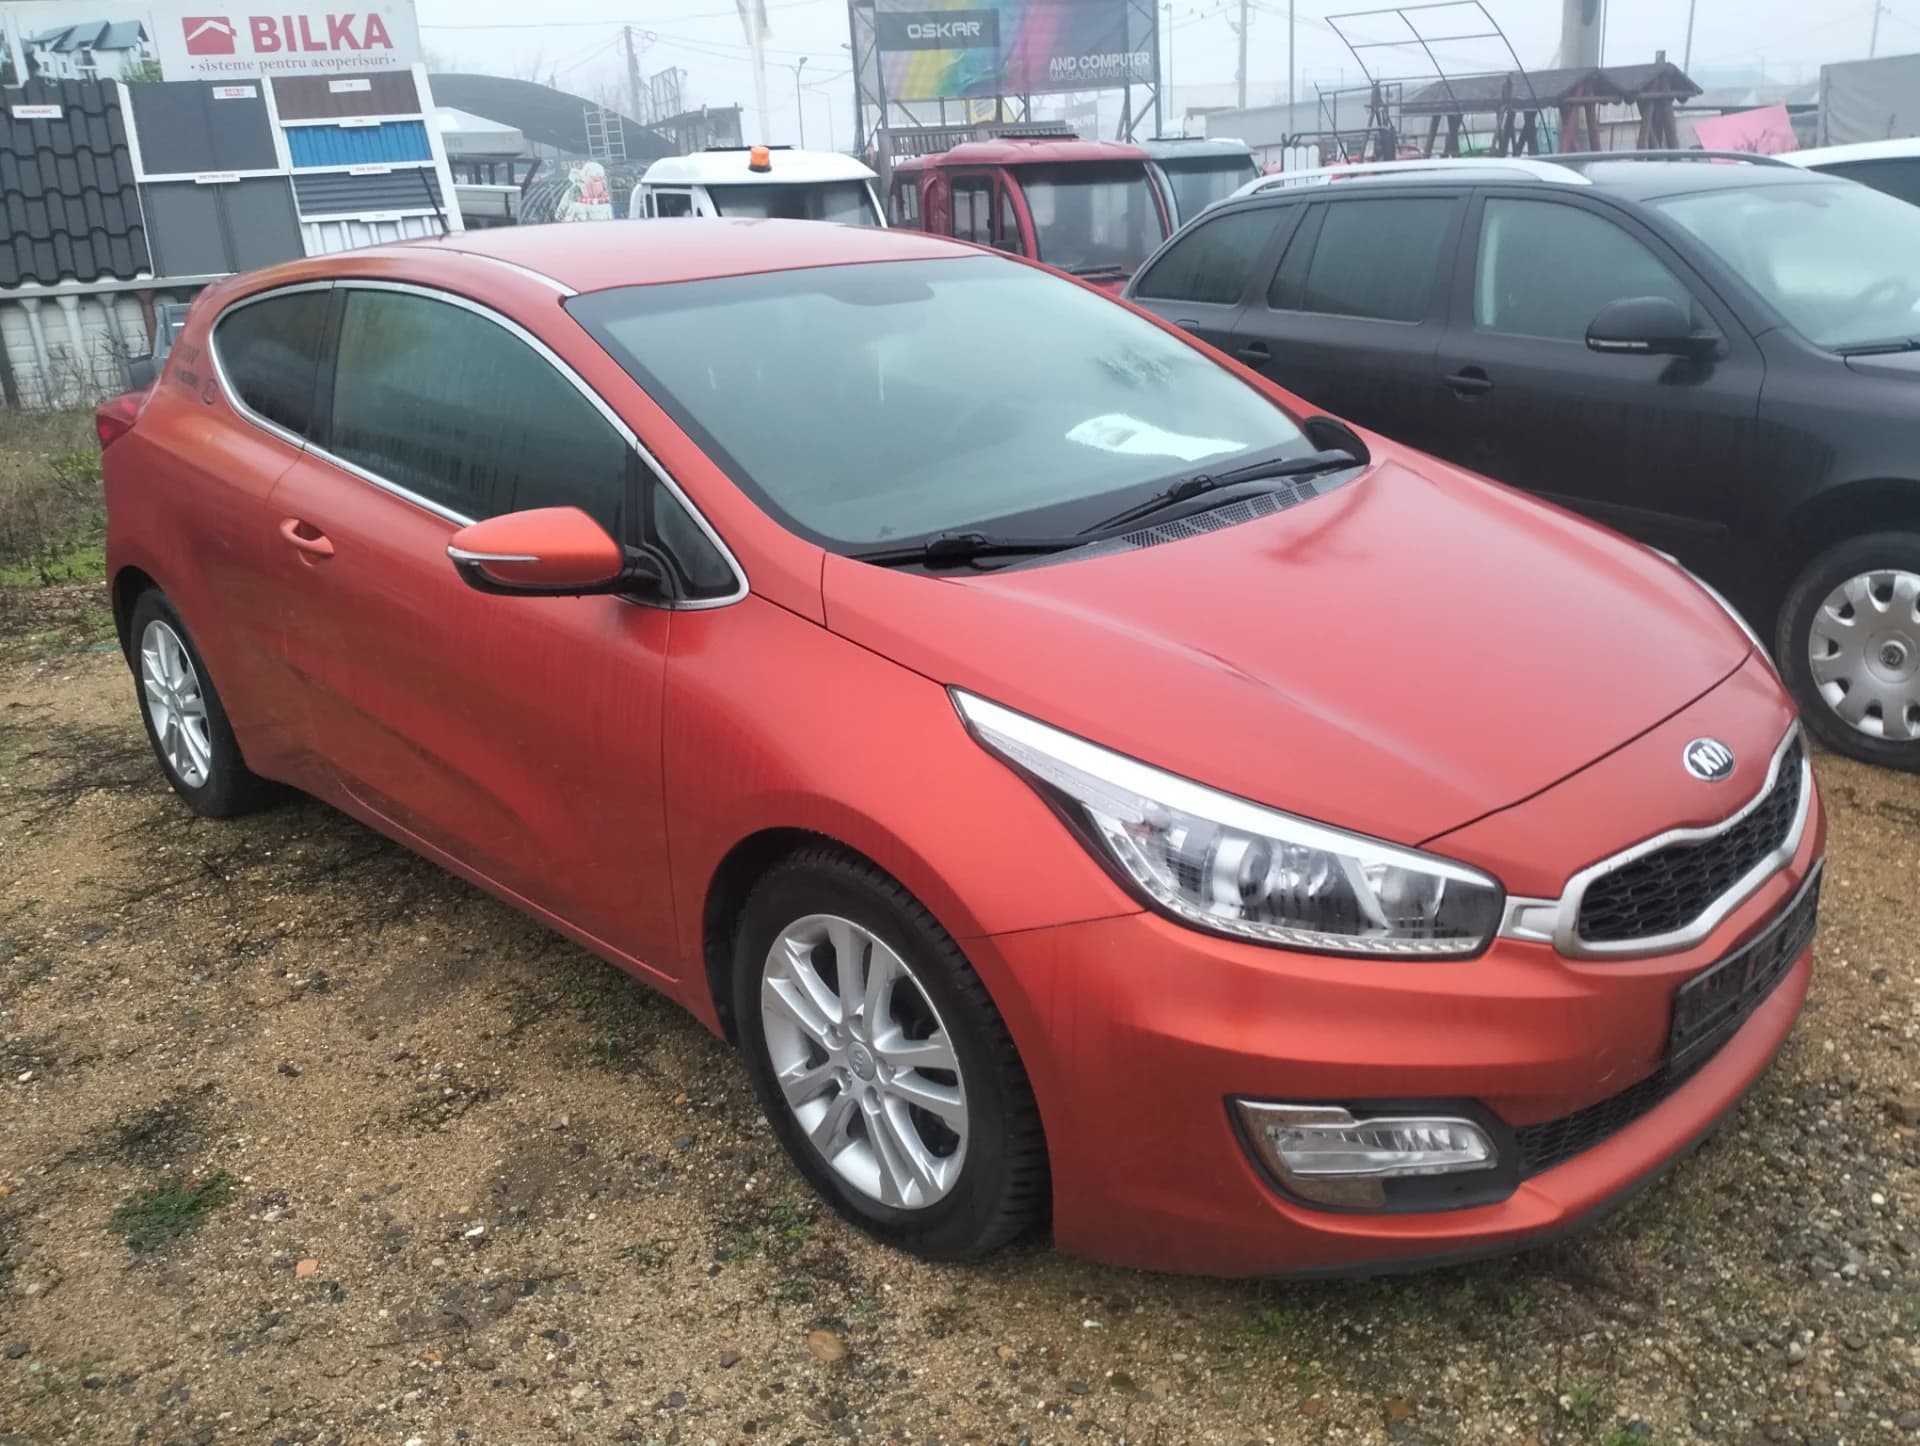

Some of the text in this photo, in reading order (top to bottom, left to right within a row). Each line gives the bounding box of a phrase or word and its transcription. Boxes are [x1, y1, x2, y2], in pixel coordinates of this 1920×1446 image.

[248, 13, 393, 53] BILKA
[907, 22, 981, 38] OSKAR
[199, 54, 390, 73] sisteme pentru acoperisuri
[1050, 52, 1151, 71] AND COMPUTER
[1691, 743, 1733, 775] KIA
